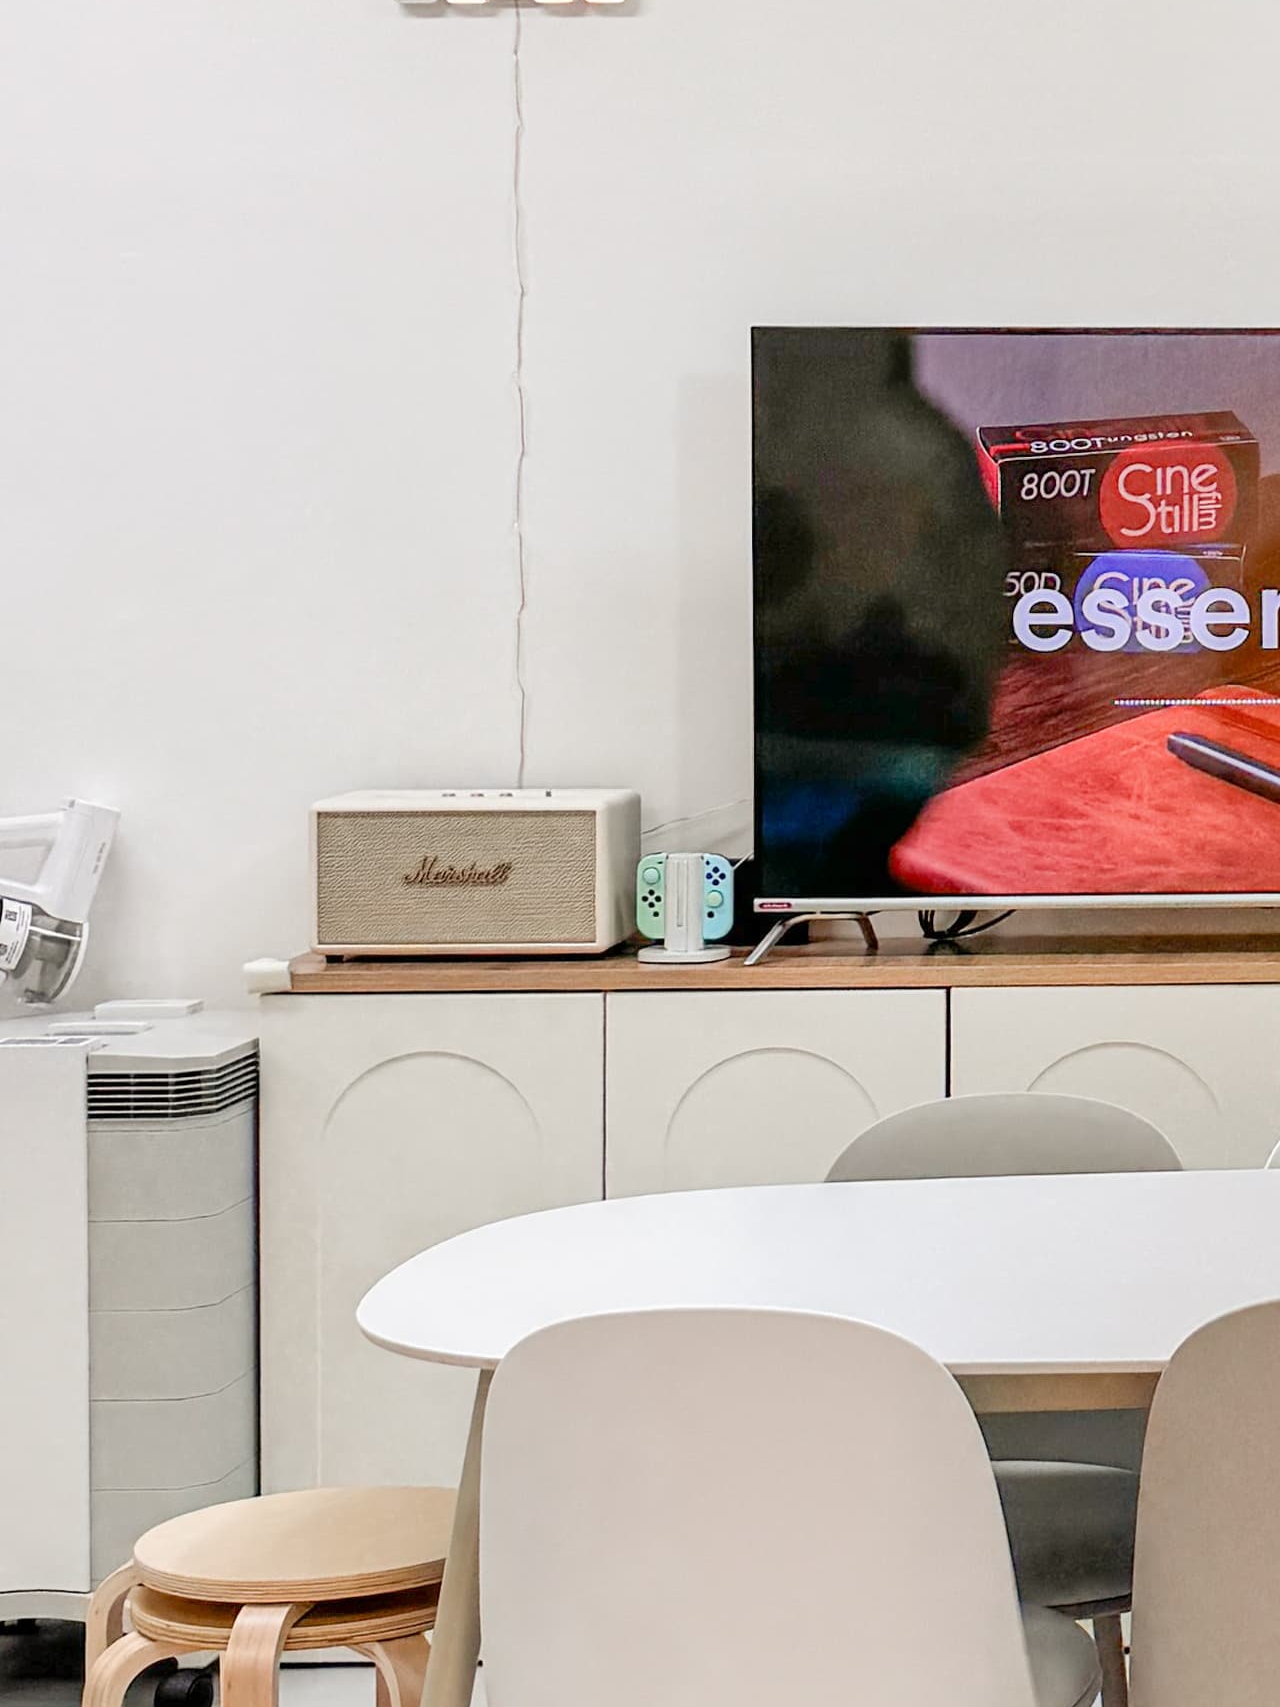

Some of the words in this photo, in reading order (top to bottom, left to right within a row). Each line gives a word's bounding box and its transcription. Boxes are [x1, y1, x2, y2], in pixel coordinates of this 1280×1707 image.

[1020, 468, 1096, 501] 800T
[1118, 462, 1219, 496] Cine
[400, 855, 512, 887] Marshall
